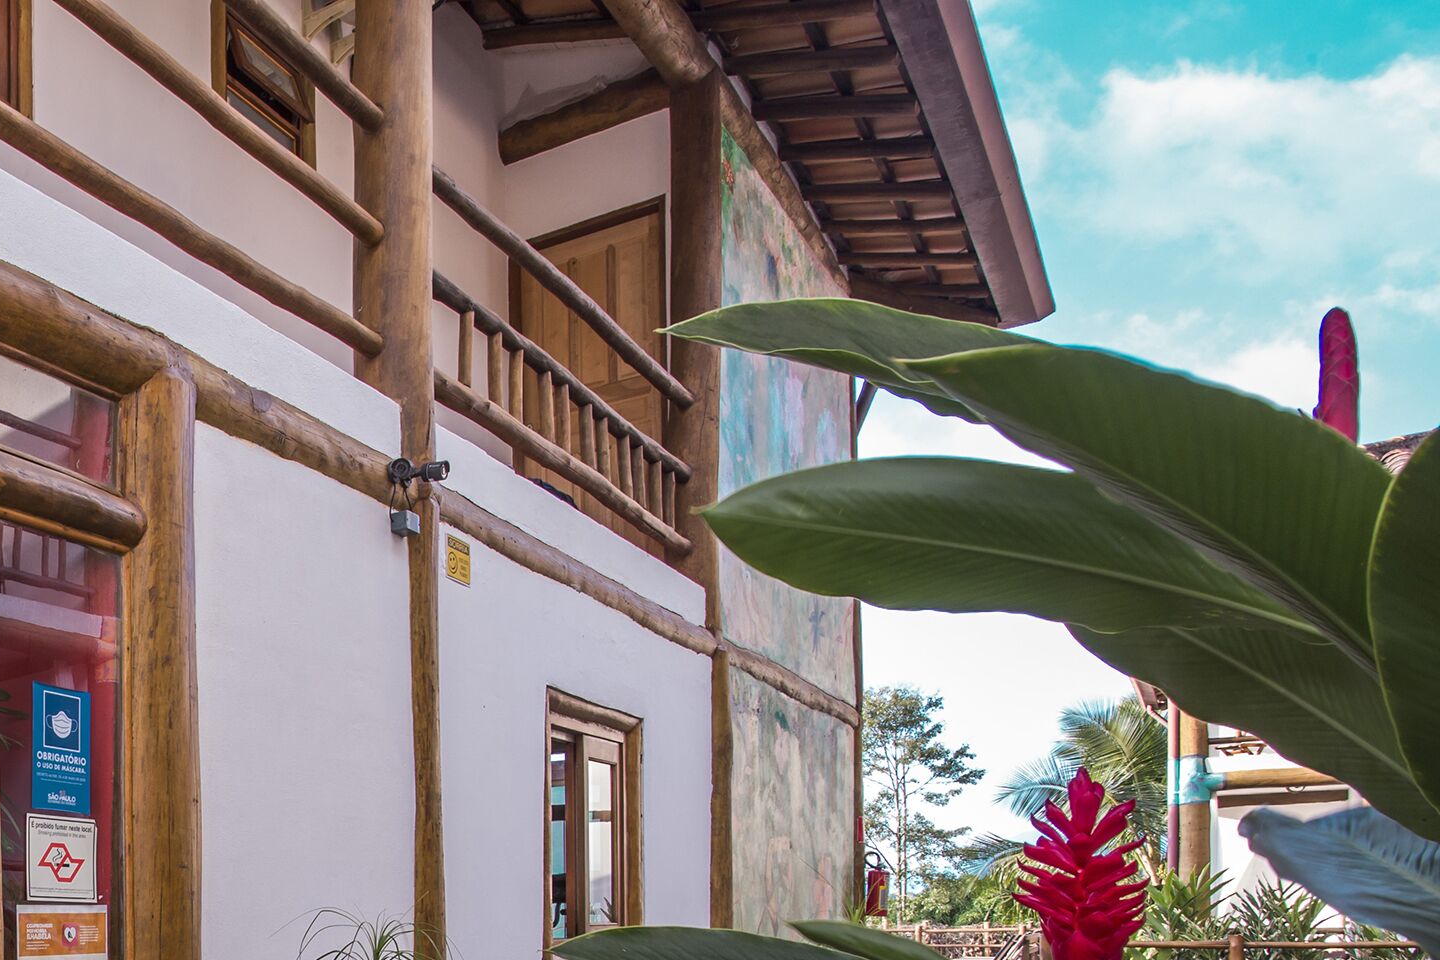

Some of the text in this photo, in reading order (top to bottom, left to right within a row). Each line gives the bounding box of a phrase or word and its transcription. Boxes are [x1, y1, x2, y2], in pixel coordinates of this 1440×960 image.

[36, 750, 87, 766] OBRIGATÓRIO
[42, 762, 53, 770] USO
[48, 792, 59, 800] SÃO
[36, 822, 54, 830] proibido
